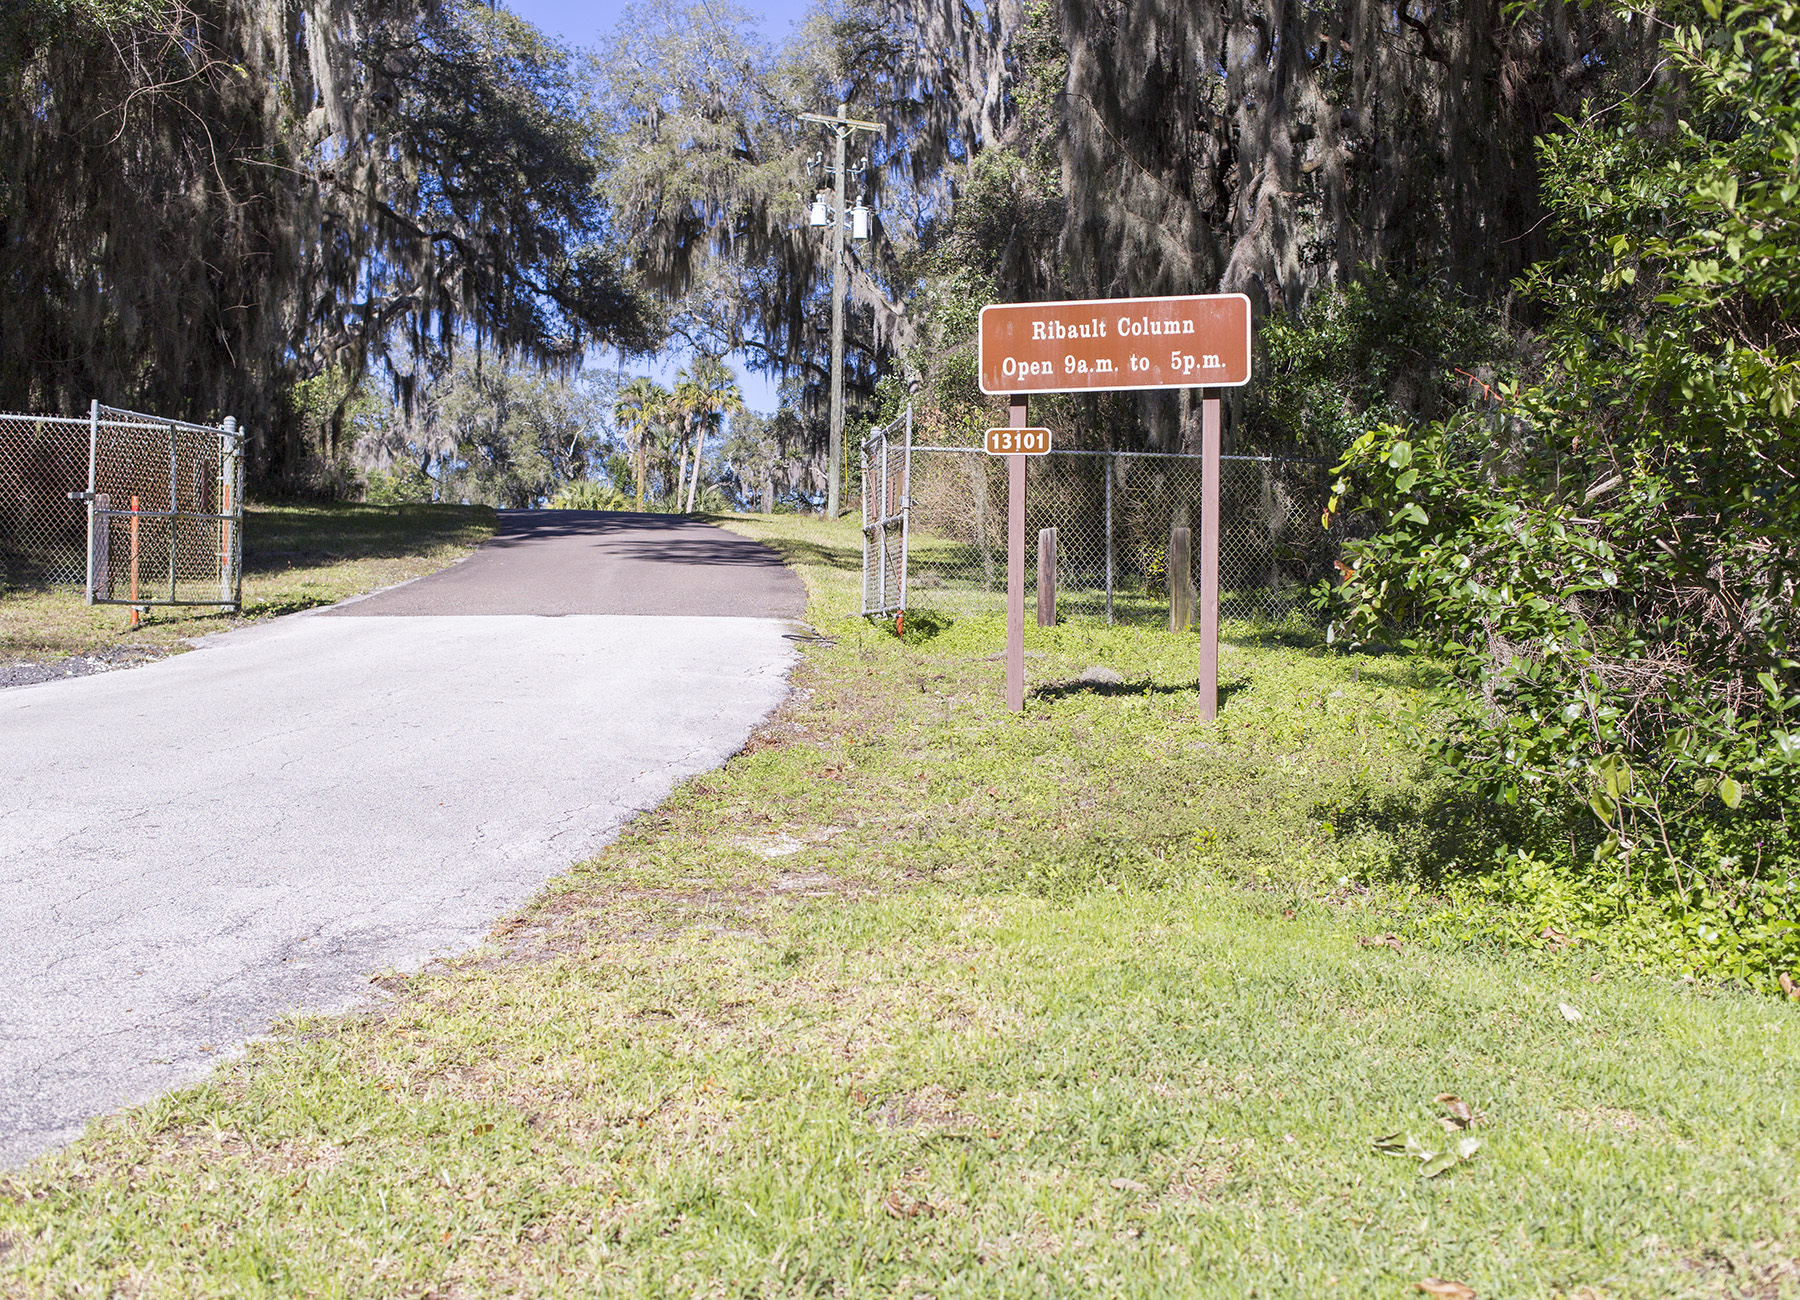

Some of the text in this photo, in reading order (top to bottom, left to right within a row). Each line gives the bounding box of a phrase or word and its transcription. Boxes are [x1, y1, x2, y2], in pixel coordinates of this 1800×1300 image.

[1032, 316, 1195, 340] Ribault Column
[1002, 351, 1227, 381] Open 9a.m. to 5p.m.
[991, 432, 1044, 450] 13101
